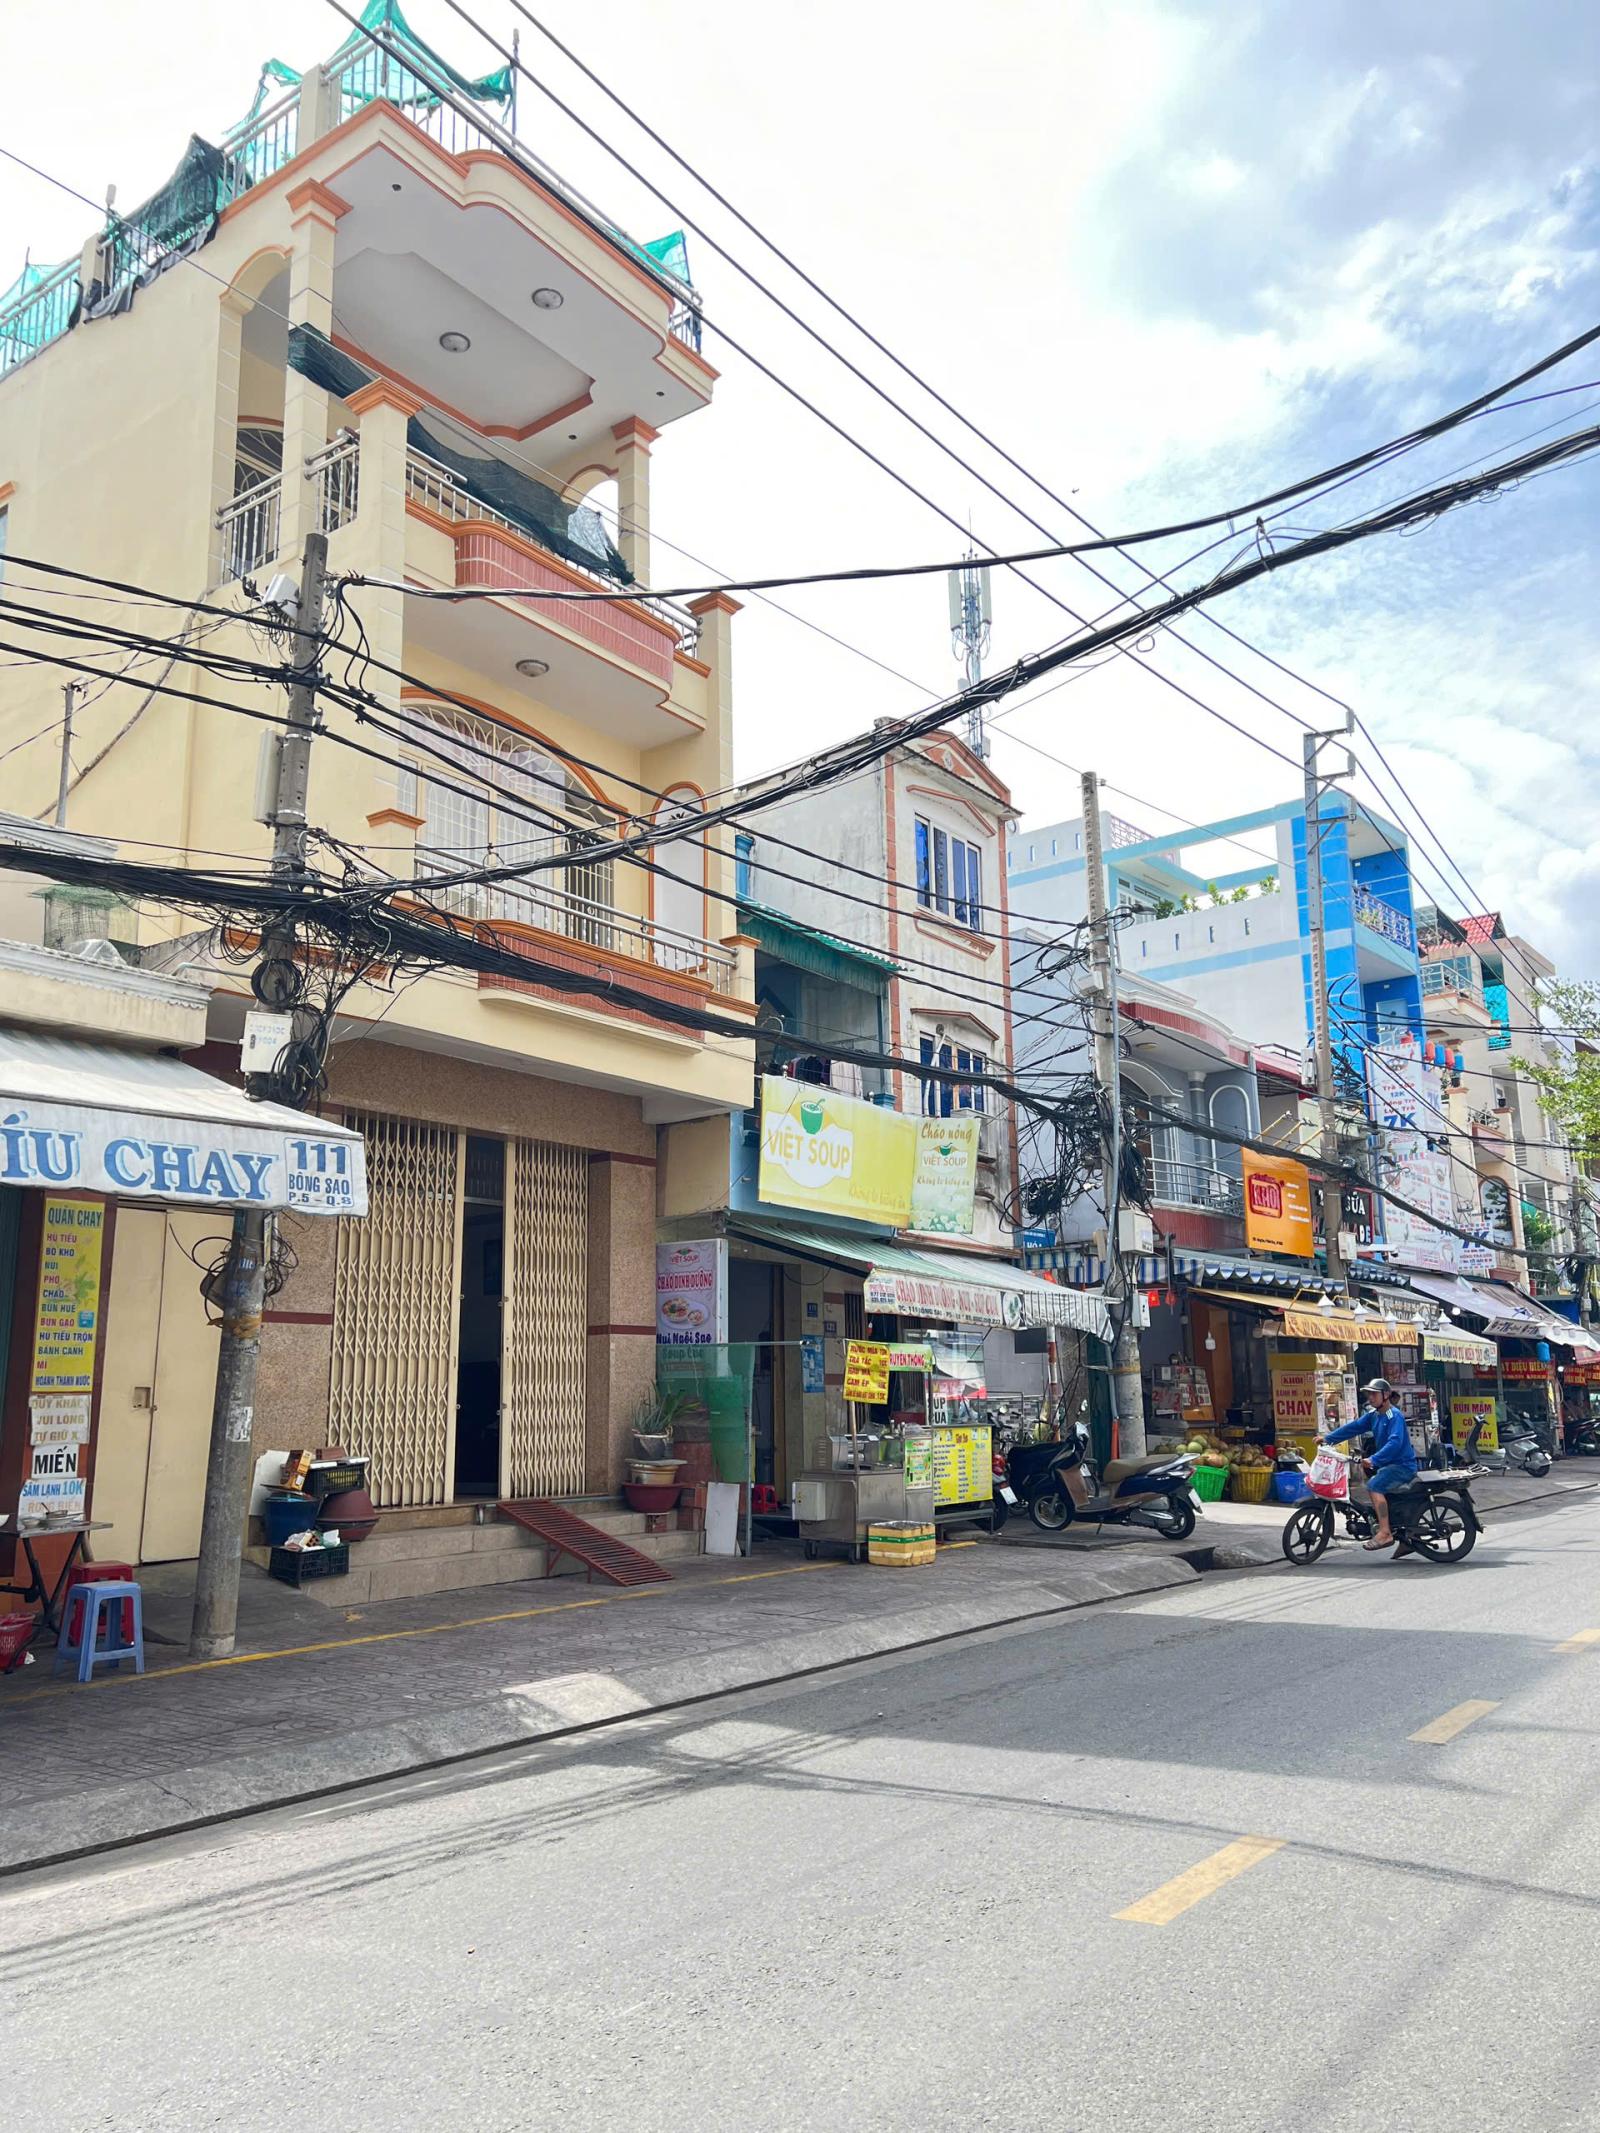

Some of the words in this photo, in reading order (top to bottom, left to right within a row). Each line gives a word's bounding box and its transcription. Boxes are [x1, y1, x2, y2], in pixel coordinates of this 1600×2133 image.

[1384, 1112, 1417, 1129] 7K
[921, 1122, 945, 1139] Cháo
[767, 1126, 804, 1164] VIỆT
[808, 1137, 850, 1171] SOUP
[291, 1141, 346, 1174] 111
[943, 1155, 967, 1167] SOUP
[104, 1137, 277, 1201] CHAY
[289, 1171, 321, 1193] BÔNG
[325, 1177, 350, 1196] SAO
[289, 1191, 310, 1204] P.5
[326, 1195, 352, 1208] Q.8
[77, 1210, 102, 1228] CHAY
[59, 1248, 75, 1257] KHO
[674, 1273, 690, 1289] DINH
[656, 1333, 671, 1345] Nui
[695, 1331, 713, 1345] Sao
[62, 1347, 83, 1356] CANH
[1277, 1400, 1313, 1416] CHAY
[34, 1446, 76, 1475] MIẾN
[22, 1481, 39, 1497] SÂM
[41, 1483, 61, 1498] LẠNH
[62, 1480, 83, 1496] 10K
